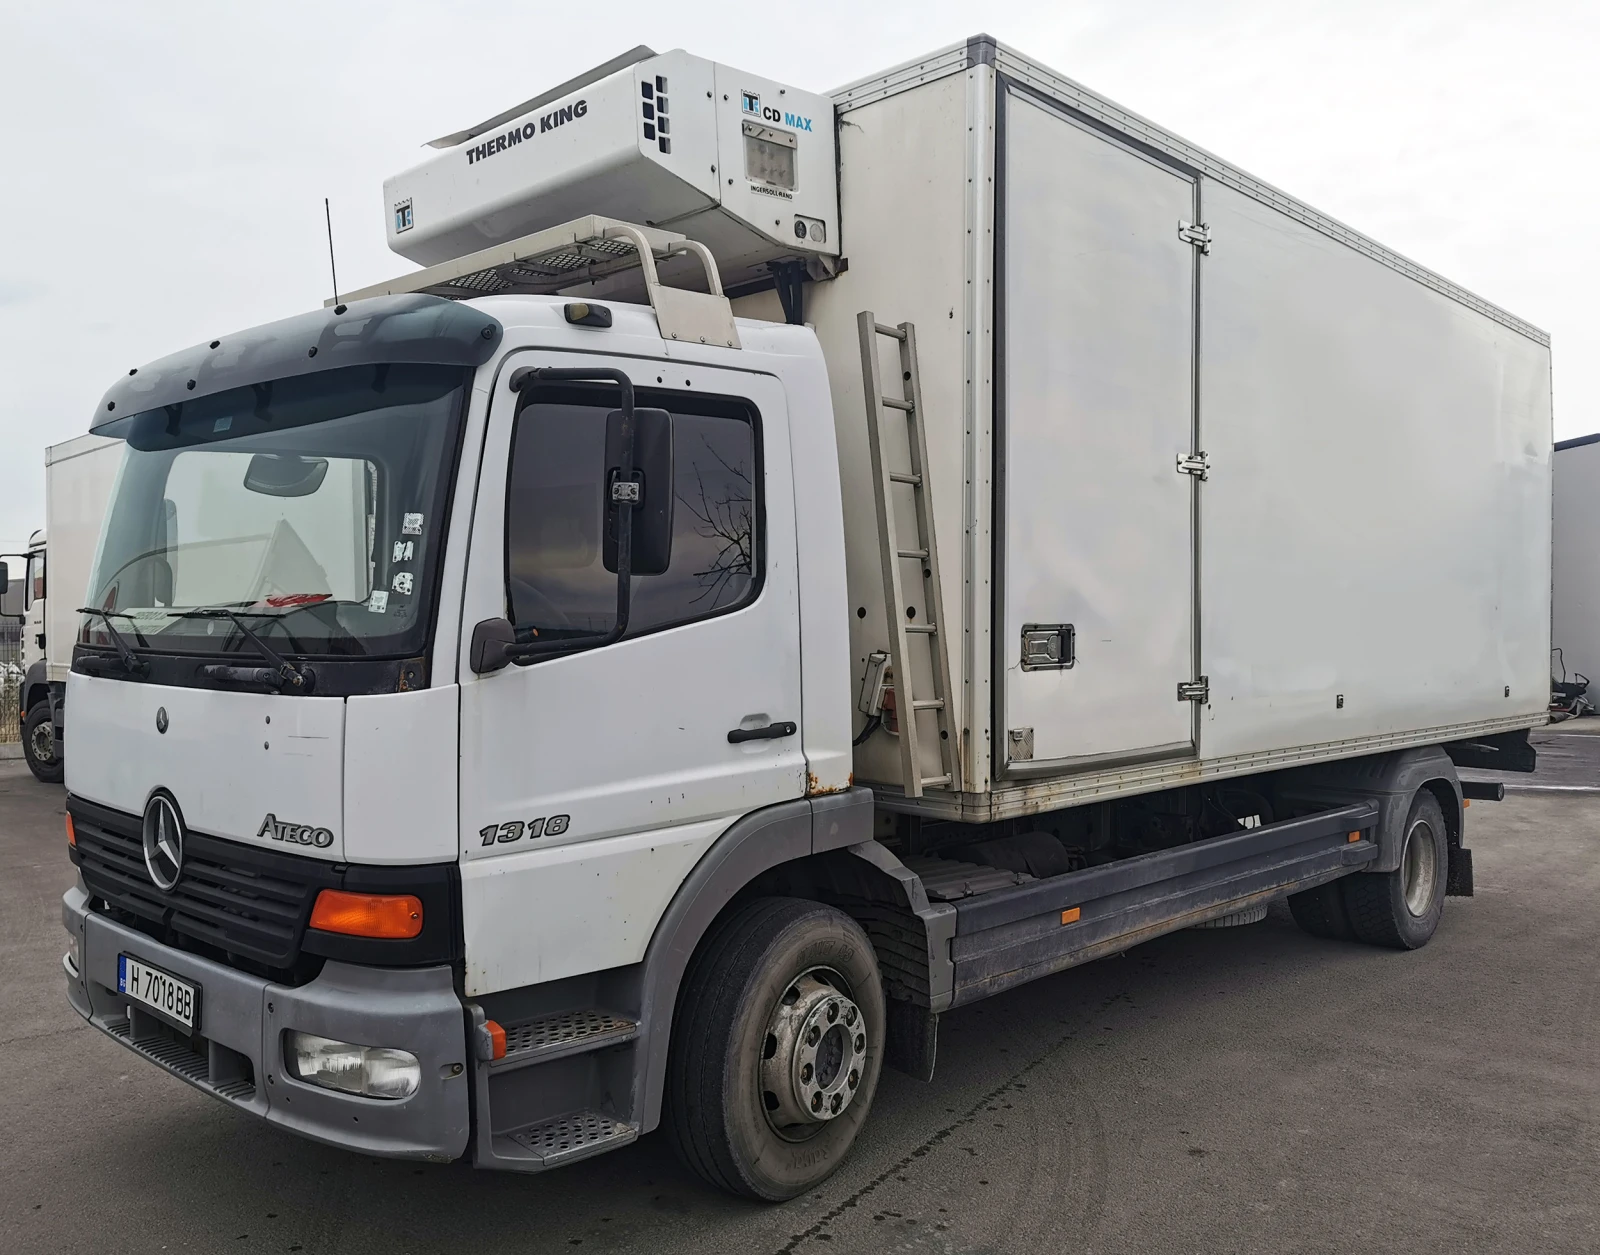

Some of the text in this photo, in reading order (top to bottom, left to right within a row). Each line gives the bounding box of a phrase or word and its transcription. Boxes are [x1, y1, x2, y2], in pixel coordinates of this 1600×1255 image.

[466, 100, 588, 165] THERMO KING
[763, 106, 812, 132] CD MAX
[479, 814, 571, 847] 1318
[131, 964, 139, 995] H
